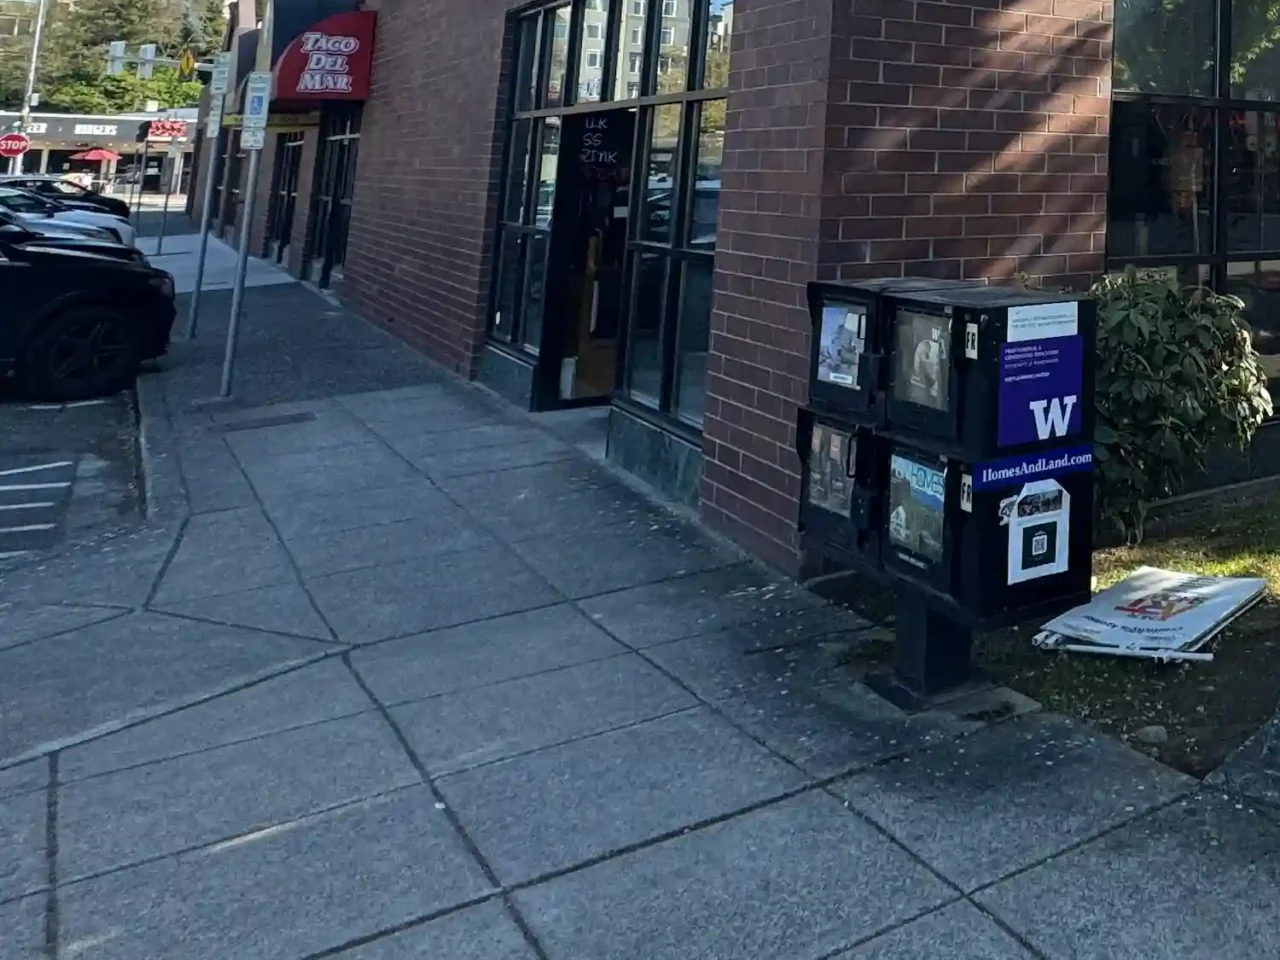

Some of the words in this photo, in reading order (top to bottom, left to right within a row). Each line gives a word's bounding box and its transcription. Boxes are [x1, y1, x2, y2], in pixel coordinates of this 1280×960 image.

[301, 32, 359, 54] TACO
[307, 54, 348, 72] DEL
[298, 73, 351, 92] MAR
[0, 141, 27, 150] STOP
[1029, 395, 1077, 440] W
[982, 453, 1092, 482] HomesAndLand.com
